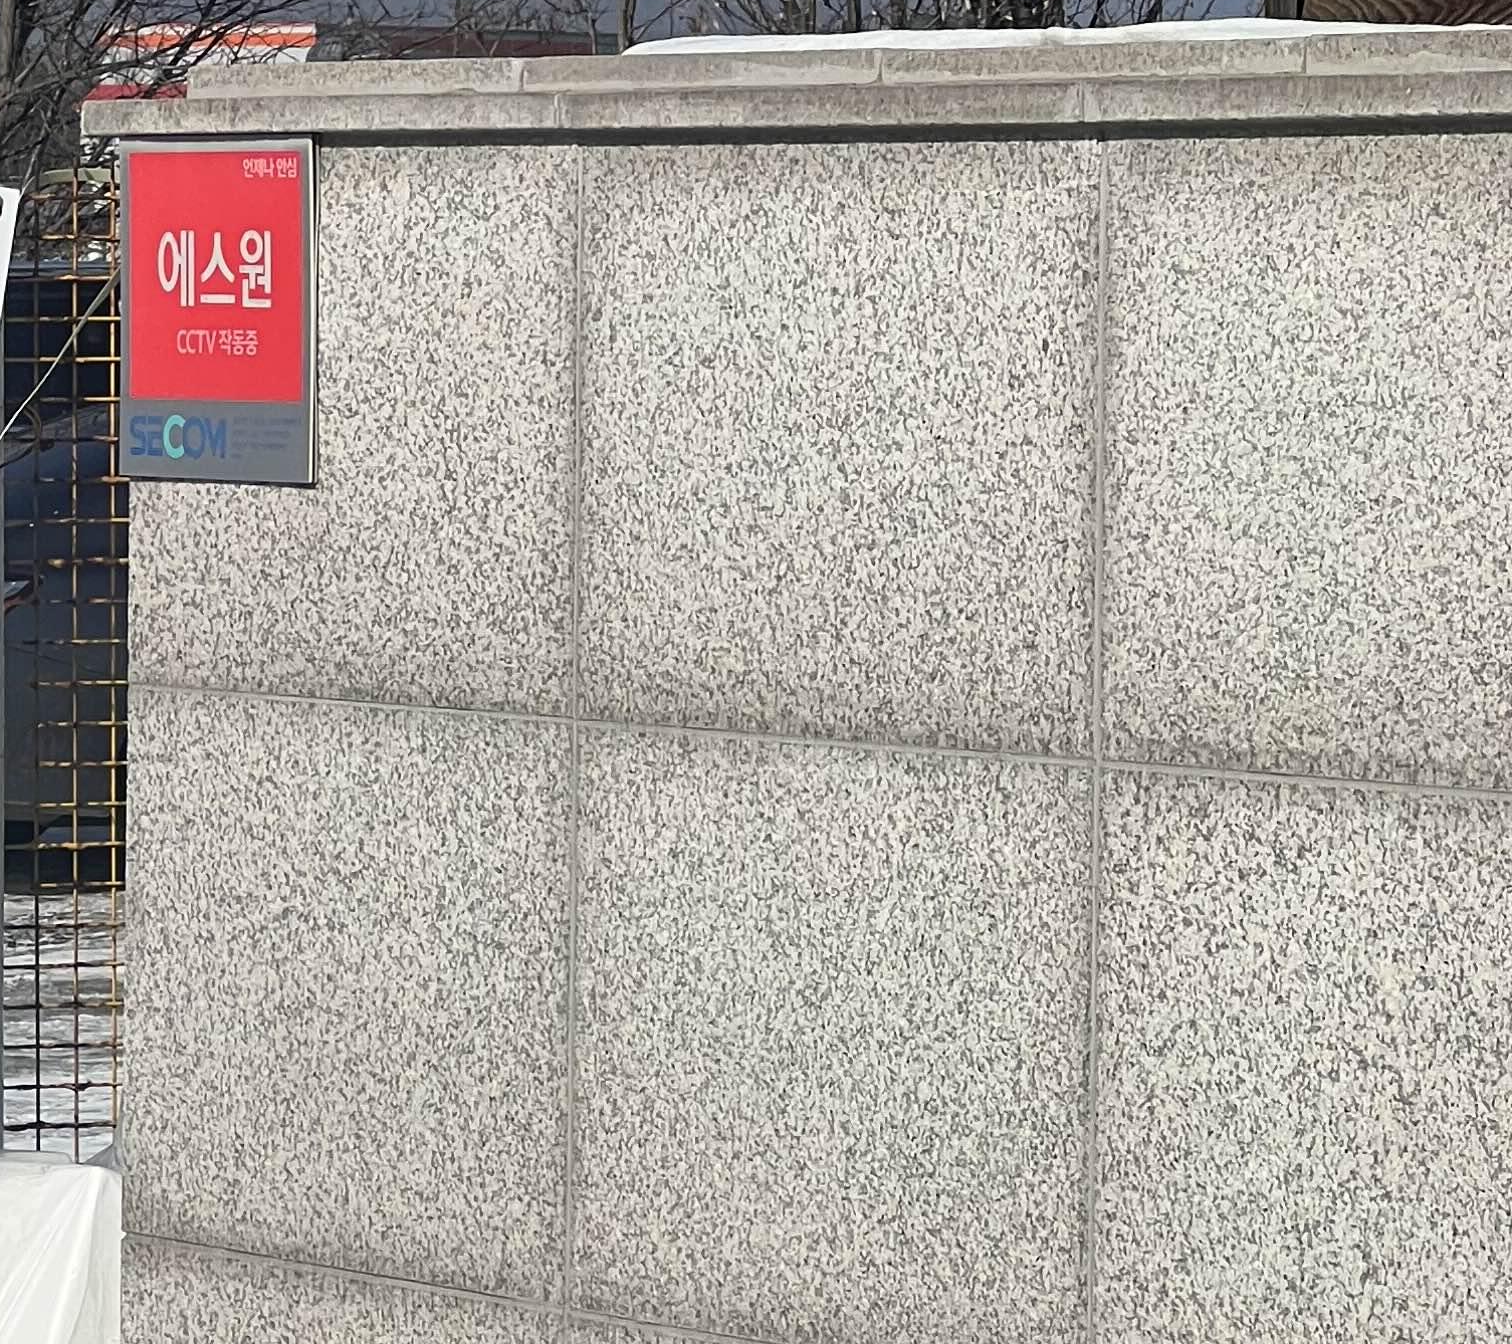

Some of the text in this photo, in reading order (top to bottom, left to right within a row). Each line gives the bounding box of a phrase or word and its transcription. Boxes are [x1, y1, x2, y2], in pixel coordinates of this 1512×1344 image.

[157, 229, 272, 309] 에스원
[177, 329, 259, 356] CCTV 작동중
[129, 414, 227, 460] SECOM
